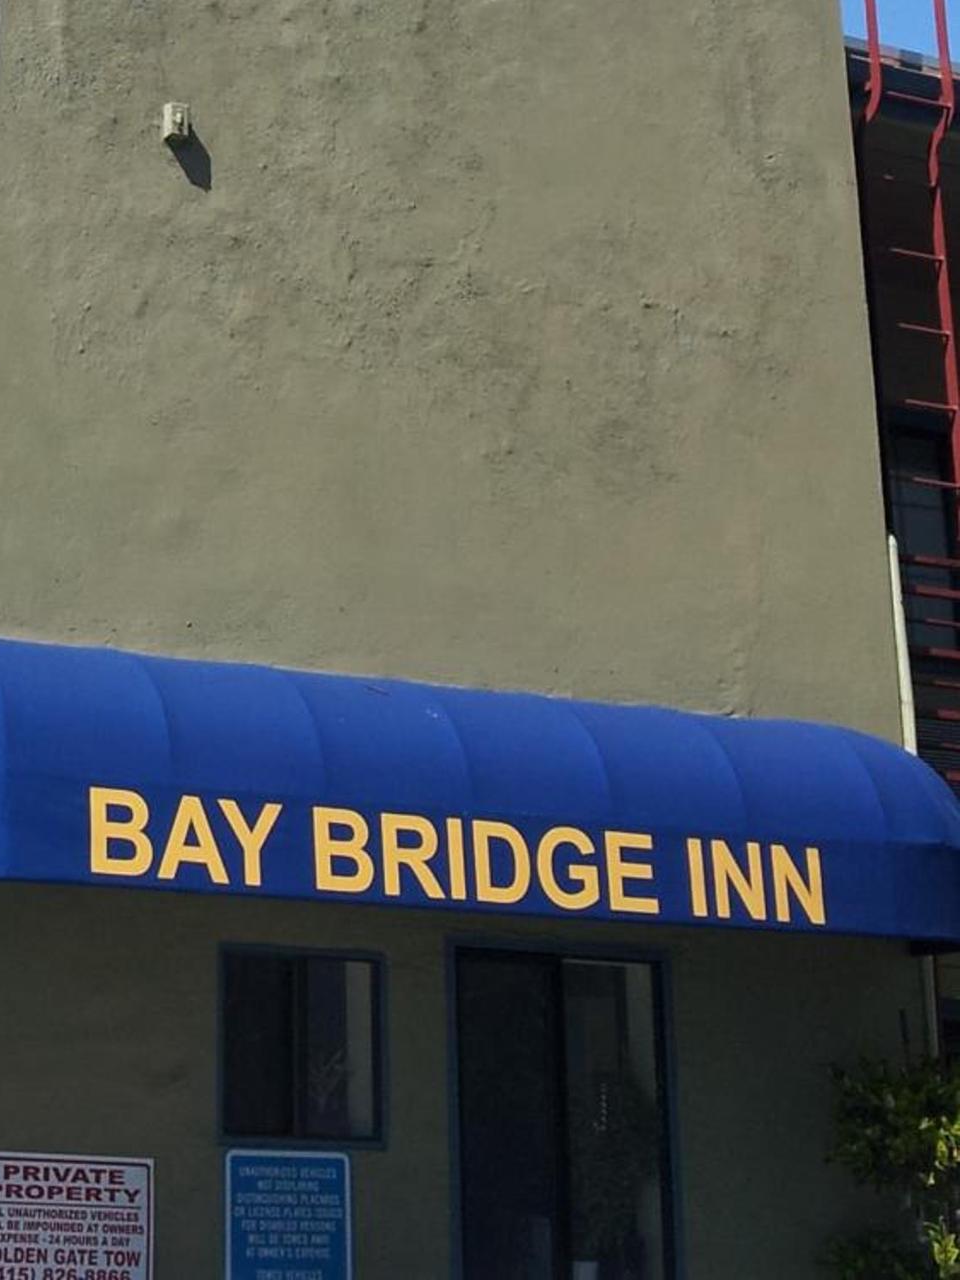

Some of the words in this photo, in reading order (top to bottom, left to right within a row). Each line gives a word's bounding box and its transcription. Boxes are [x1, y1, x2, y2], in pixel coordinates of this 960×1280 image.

[89, 786, 282, 886] BAY
[312, 805, 660, 914] BRIDGE
[687, 837, 826, 925] INN
[3, 1164, 126, 1185] PRIVATE
[8, 1208, 88, 1221] UNAUTHORIZED
[90, 1211, 139, 1222] VEHICLES
[7, 1221, 20, 1231] BE
[23, 1221, 84, 1233] IMPOUNDED
[86, 1223, 99, 1234] AT
[102, 1224, 144, 1235] OWNERS
[48, 1235, 60, 1245] 24
[63, 1235, 98, 1246] HOURS
[101, 1237, 108, 1246] A
[111, 1237, 131, 1247] DAY
[54, 1248, 98, 1266] GATE
[104, 1250, 141, 1267] TOW
